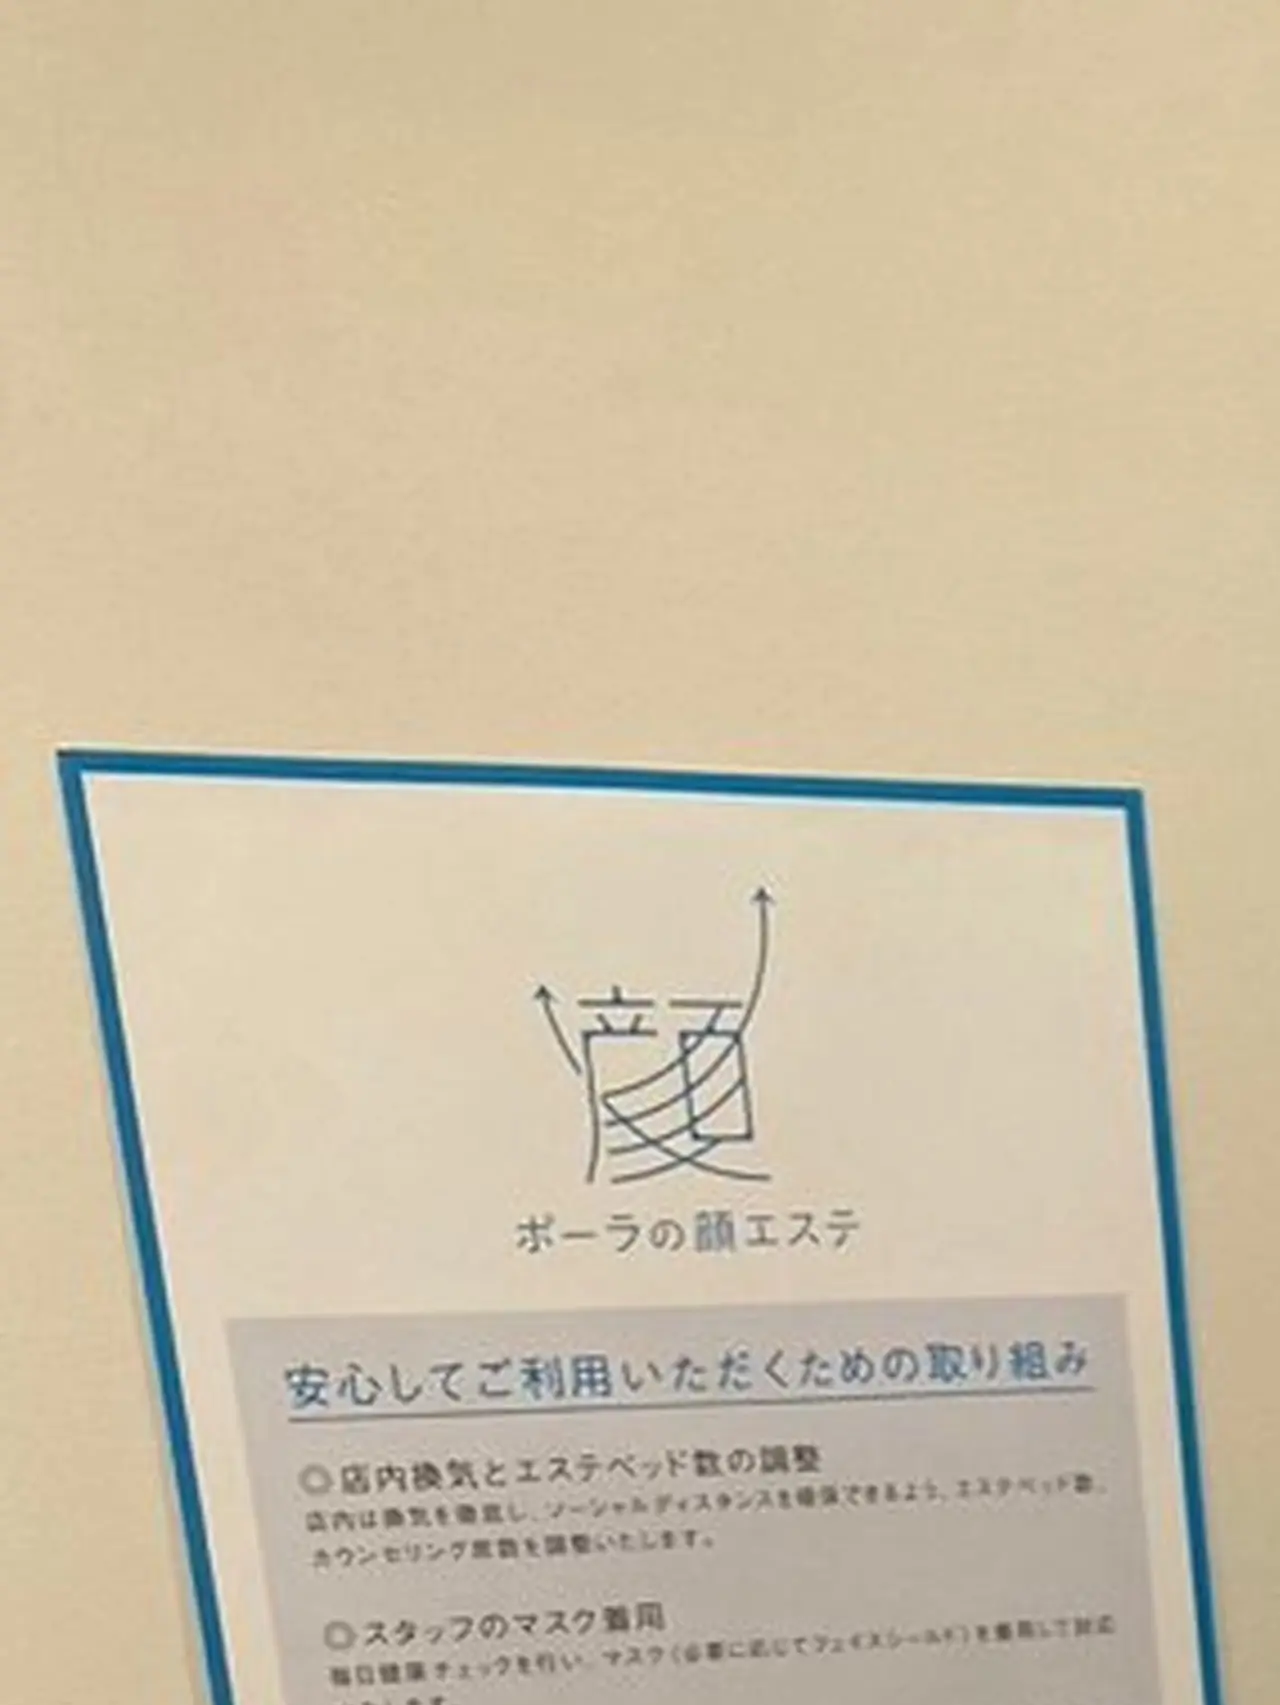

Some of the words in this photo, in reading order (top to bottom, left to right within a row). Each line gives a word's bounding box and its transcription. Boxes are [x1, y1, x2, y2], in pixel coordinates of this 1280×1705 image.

[514, 1209, 861, 1254] ポーラの顔エステ
[283, 1340, 1088, 1409] 安心してご利用いただくための取り組み
